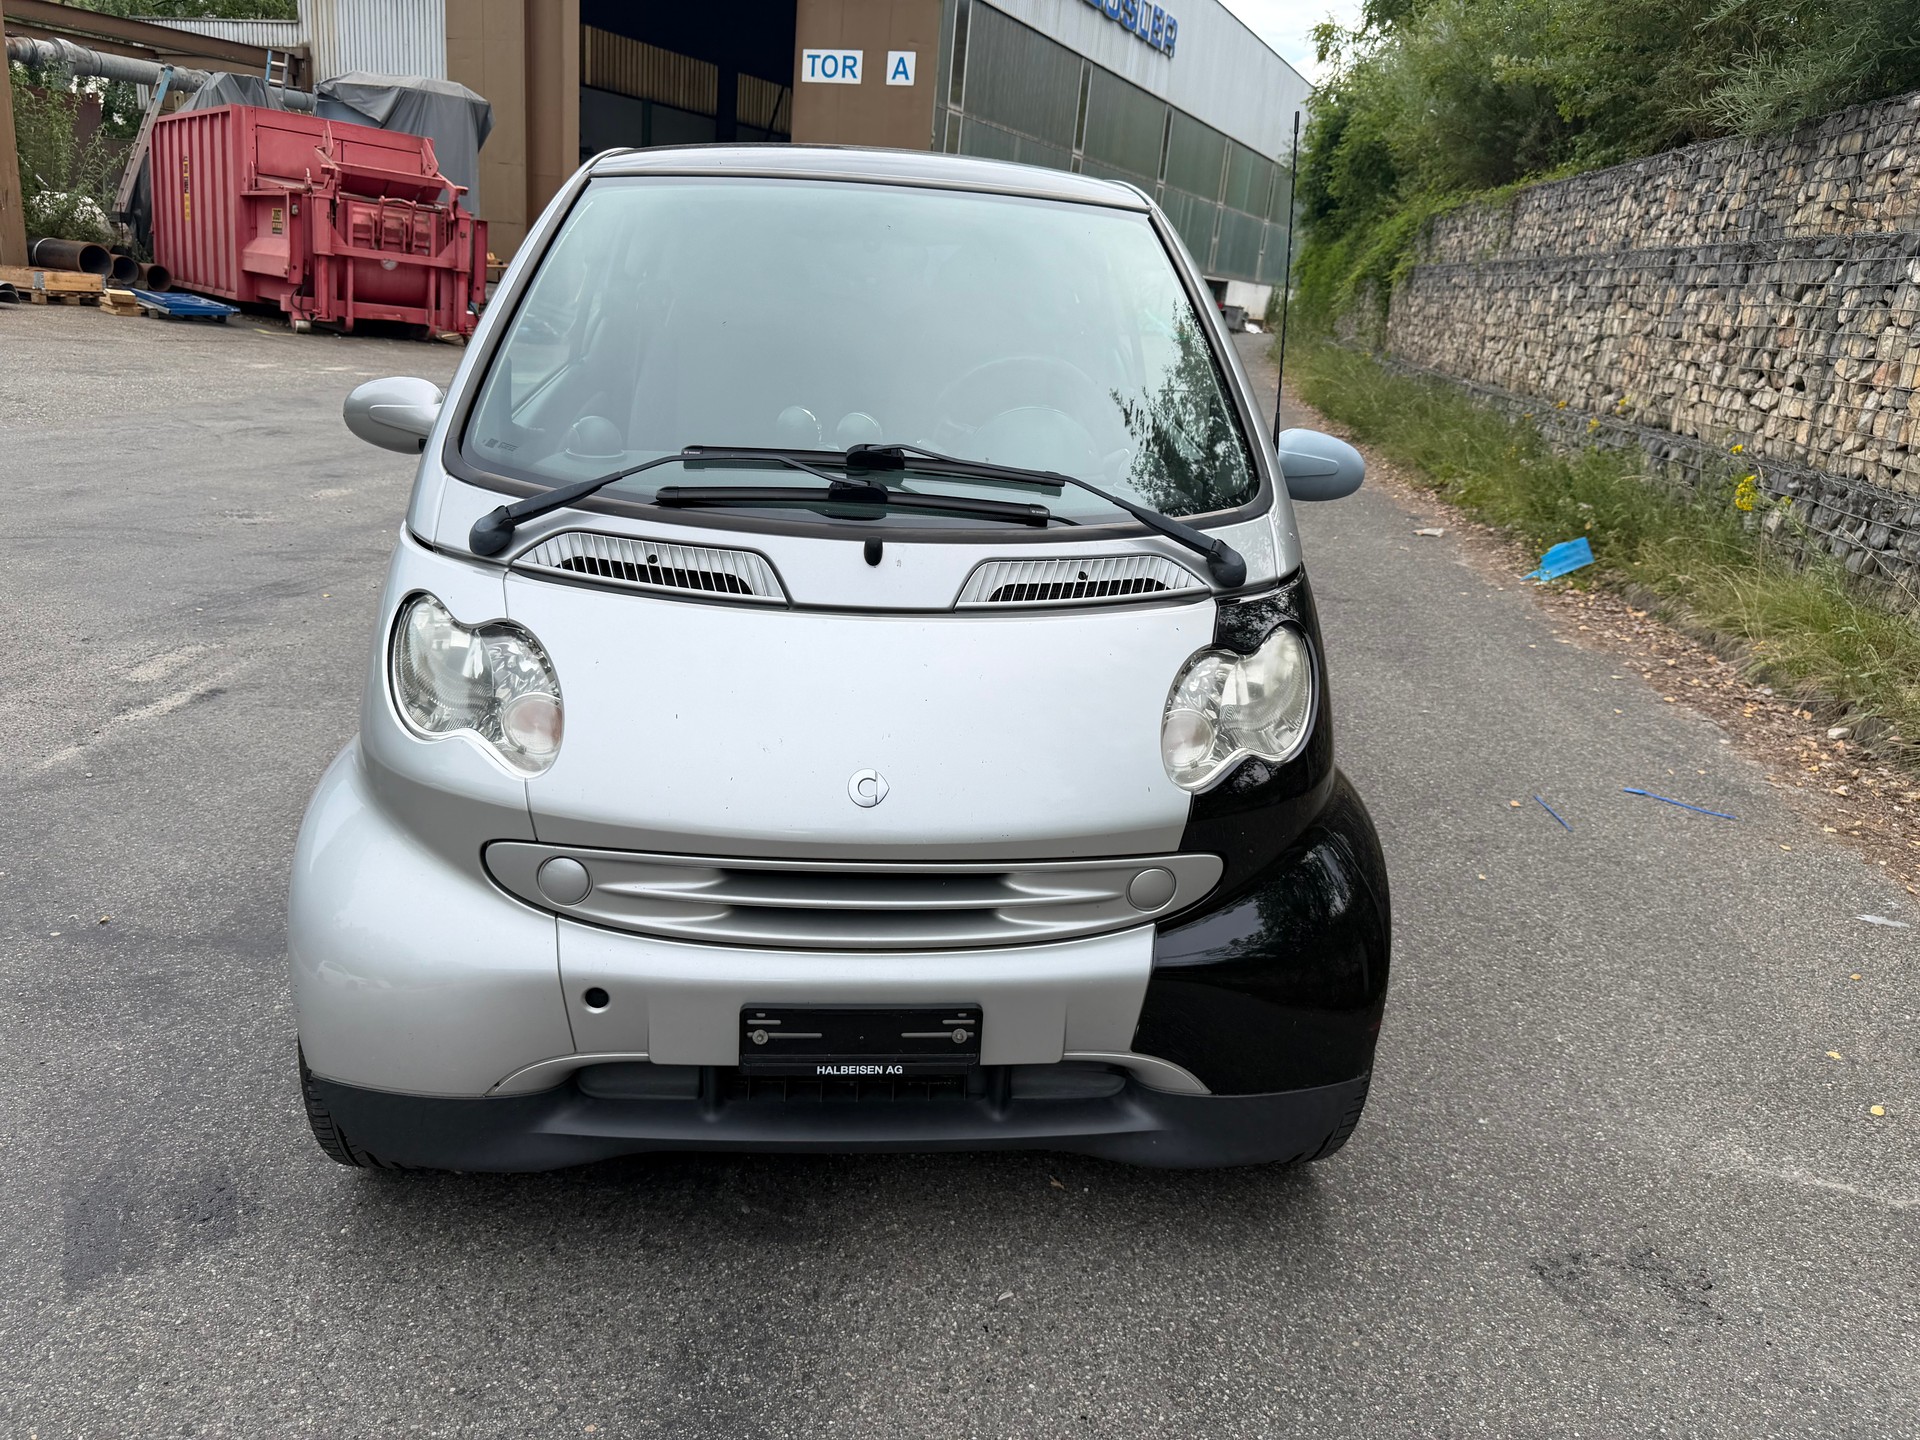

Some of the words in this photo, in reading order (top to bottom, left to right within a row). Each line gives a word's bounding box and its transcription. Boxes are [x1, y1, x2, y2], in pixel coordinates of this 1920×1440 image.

[1080, 0, 1178, 58] SLER
[807, 54, 857, 79] TOR
[891, 56, 910, 80] A
[816, 1065, 883, 1075] HALBEISEN
[886, 1065, 903, 1075] AG
